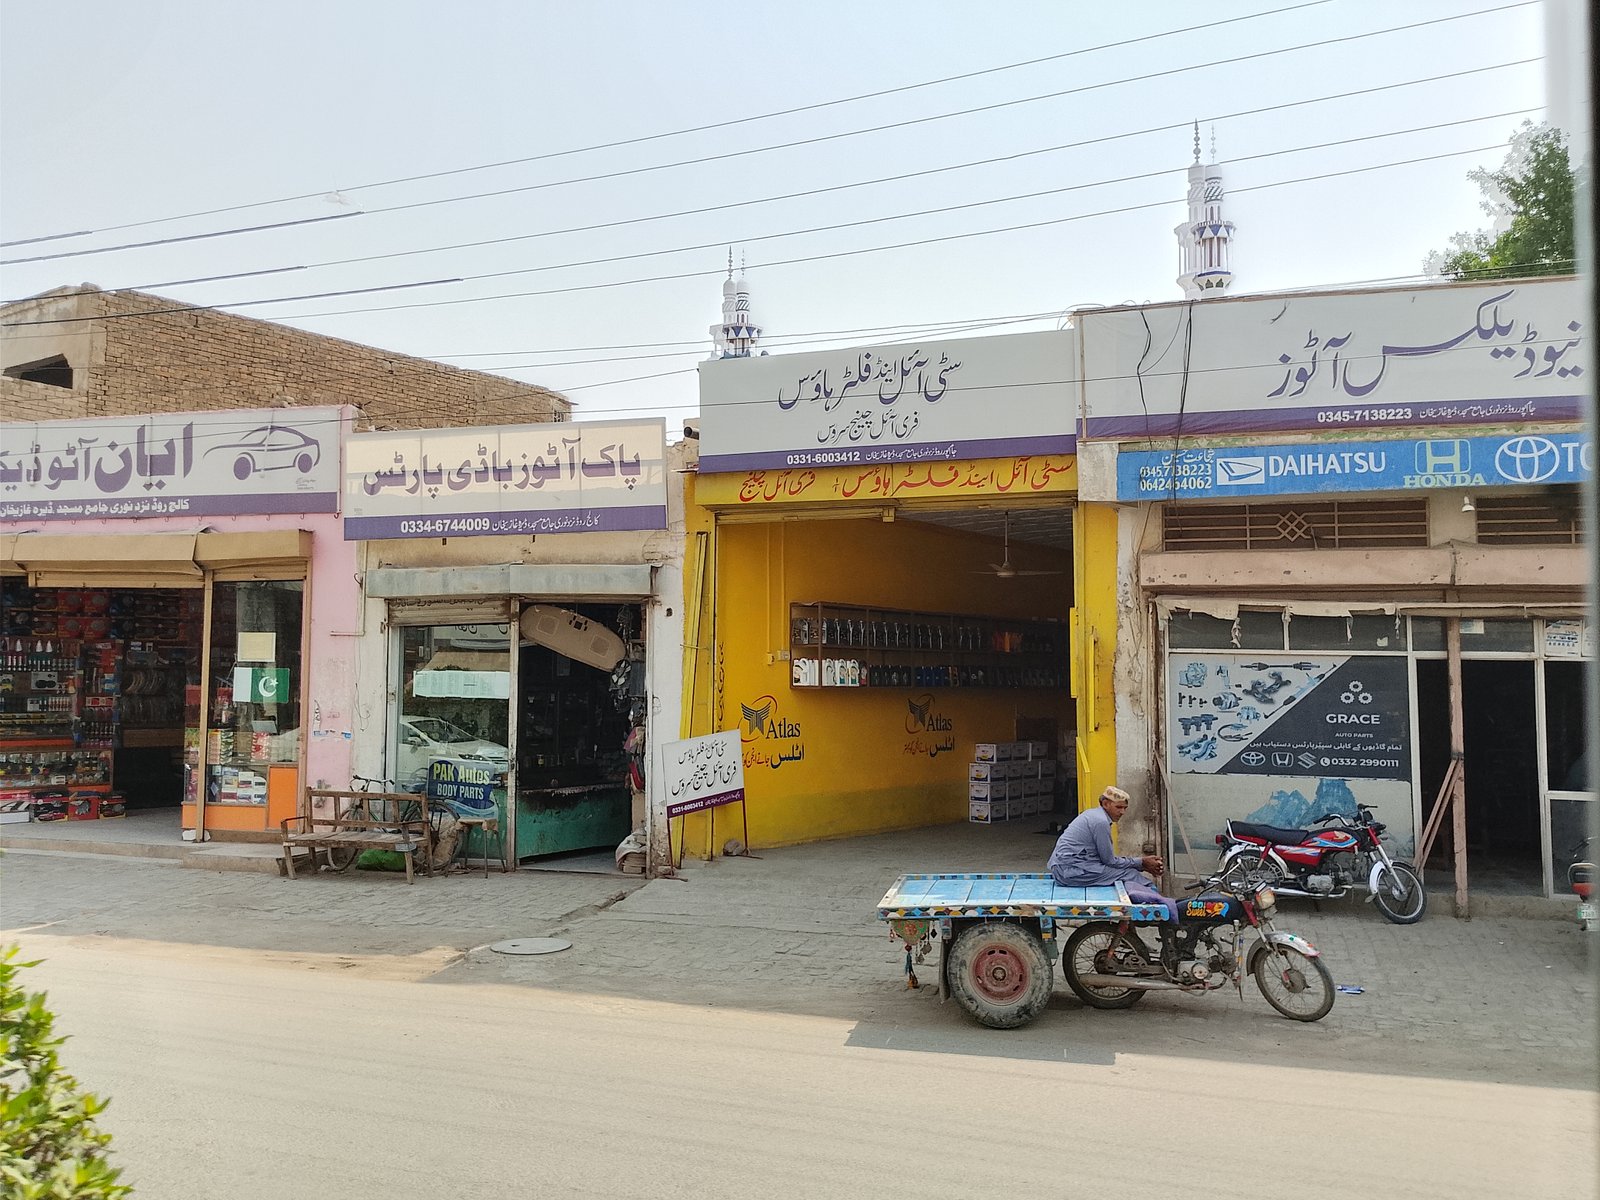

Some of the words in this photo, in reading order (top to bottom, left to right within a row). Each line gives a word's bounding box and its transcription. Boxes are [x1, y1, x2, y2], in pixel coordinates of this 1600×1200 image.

[874, 357, 897, 383] اینڈ
[1267, 329, 1352, 398] آٹوز
[831, 352, 872, 410] فلٹر
[879, 349, 929, 405] آئل
[924, 352, 962, 403] سٹی
[779, 368, 834, 412] ہاؤس
[870, 409, 897, 440] آئل
[895, 411, 920, 439] فری
[1317, 408, 1412, 423] 0345-7138223
[817, 423, 850, 445] سروس
[44, 437, 99, 491] آٹو
[94, 421, 194, 493] ایان
[448, 443, 512, 491] باڈی
[515, 437, 581, 490] آٹوز
[581, 443, 641, 491] پاک
[787, 451, 860, 465] 0331-6003412
[1269, 452, 1386, 476] DAIHATSU
[363, 451, 444, 499] پارٹس
[763, 470, 793, 502] آئل
[789, 470, 816, 495] فری
[842, 465, 891, 498] ہاؤس
[891, 465, 959, 497] فلٹر
[959, 464, 994, 489] اینڈ
[996, 457, 1029, 493] آئل
[1031, 460, 1073, 490] سٹی
[1403, 473, 1487, 488] HONDA
[84, 501, 109, 516] جامع
[110, 502, 133, 514] نوری
[135, 501, 151, 513] نزد
[151, 498, 167, 513] روڈ
[168, 499, 190, 513] کالج
[401, 518, 490, 533] 0334-6744009
[766, 718, 801, 740] Atlas
[927, 713, 953, 732] Atlas
[1325, 713, 1381, 725] GRACE
[771, 742, 804, 769] اٹلس
[1263, 741, 1291, 749] دستیاب
[1352, 744, 1361, 752] کے
[433, 763, 455, 782] PAK
[707, 761, 724, 788] آئل
[723, 761, 737, 784] فری
[1332, 758, 1357, 766] 0332
[1360, 759, 1399, 768] 2990111
[437, 783, 458, 797] BODY
[460, 786, 484, 800] PARTS
